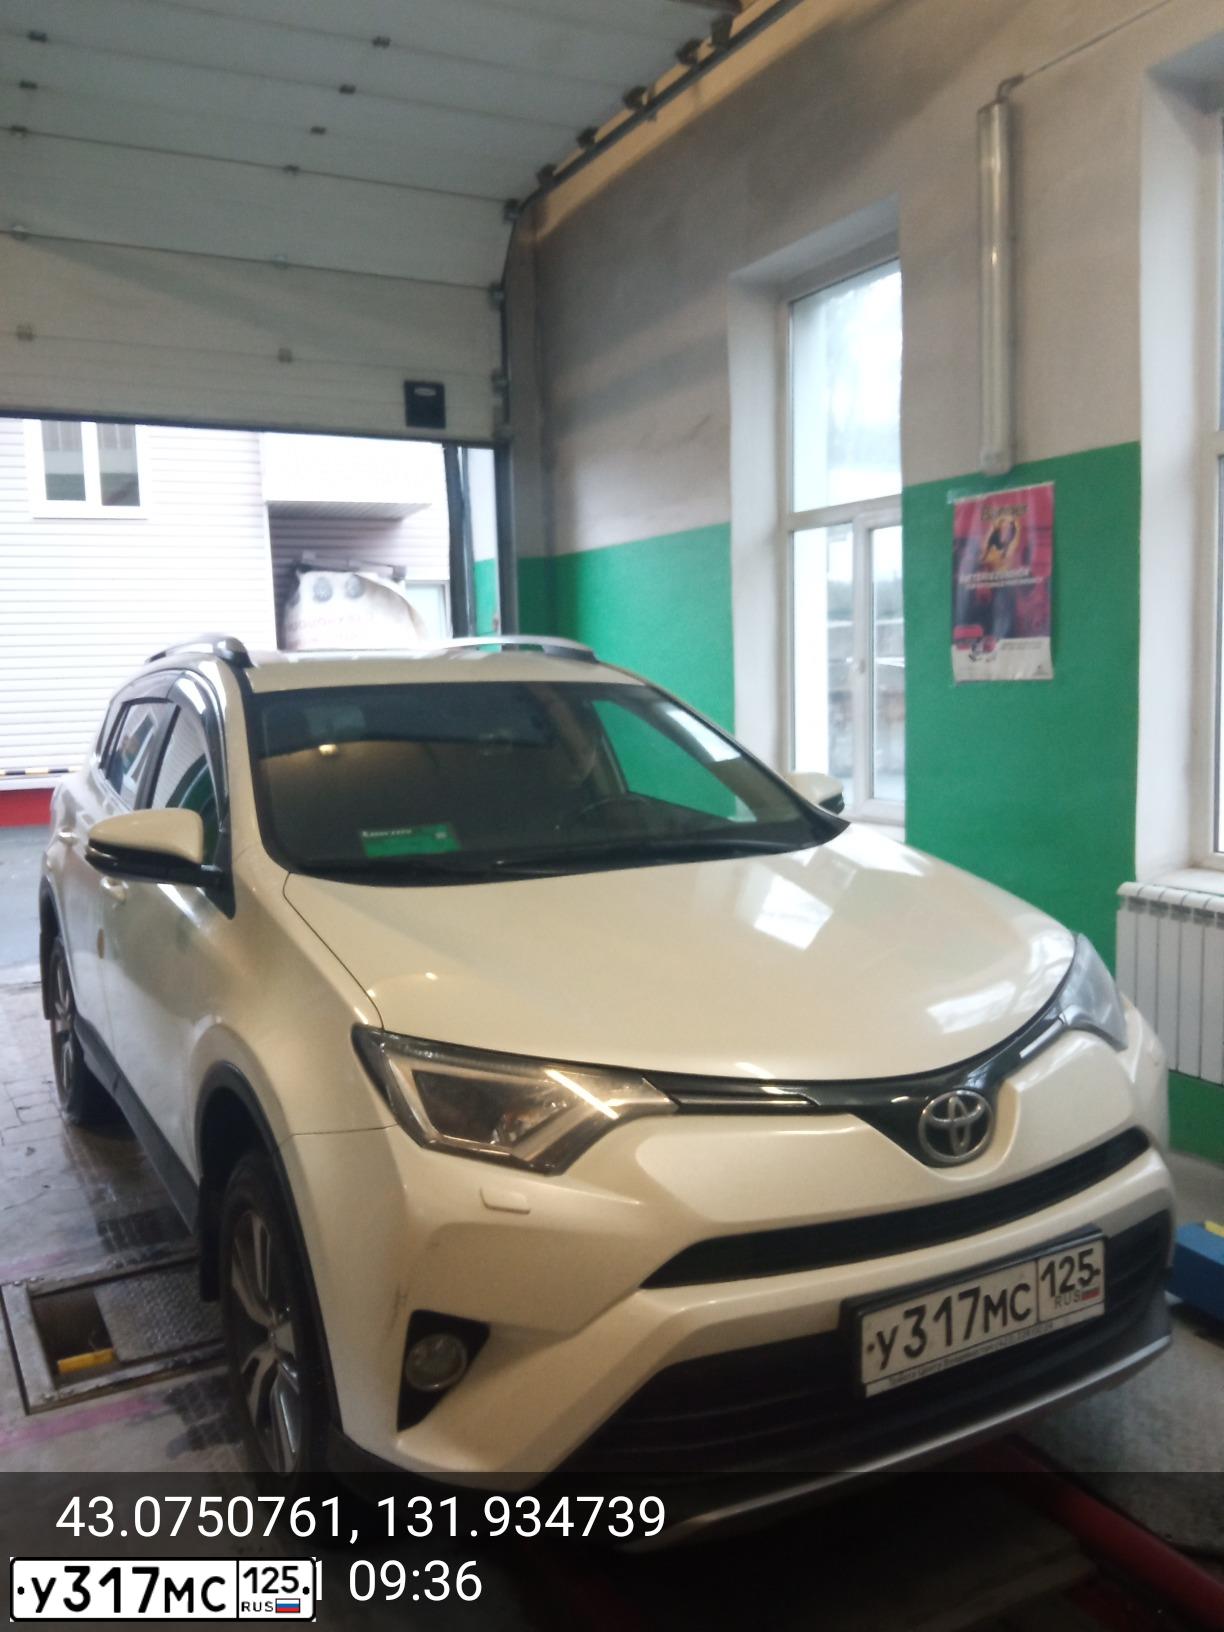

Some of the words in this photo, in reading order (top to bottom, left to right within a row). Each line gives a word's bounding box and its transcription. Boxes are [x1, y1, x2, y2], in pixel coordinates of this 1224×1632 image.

[875, 1282, 1032, 1370] У317МС
[1040, 1248, 1095, 1298] 125
[1054, 1291, 1082, 1309] RUS
